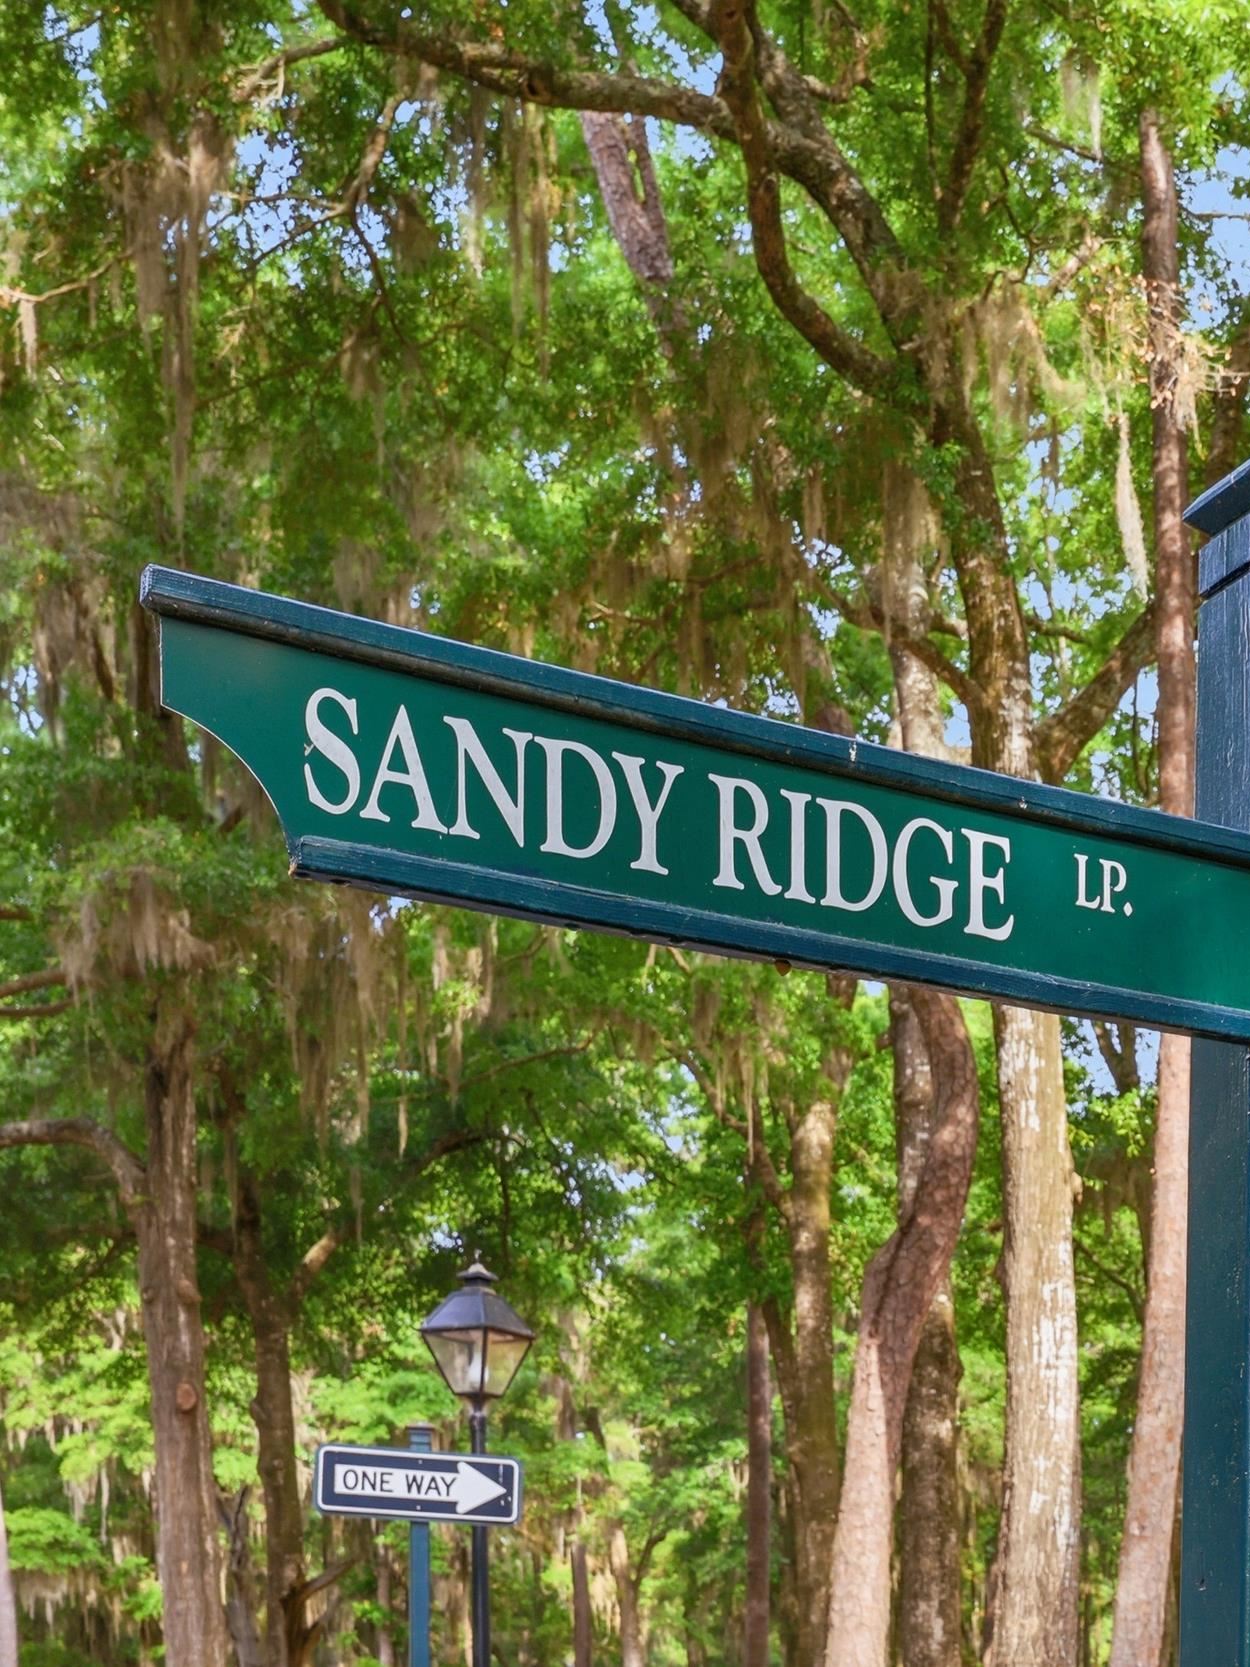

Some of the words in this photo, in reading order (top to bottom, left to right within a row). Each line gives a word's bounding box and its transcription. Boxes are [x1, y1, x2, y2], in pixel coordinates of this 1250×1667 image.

[303, 687, 684, 876] SANDY
[707, 772, 1015, 942] RIDGE
[1073, 852, 1134, 917] LP.
[343, 1469, 394, 1493] ONE
[405, 1473, 457, 1497] WAY
